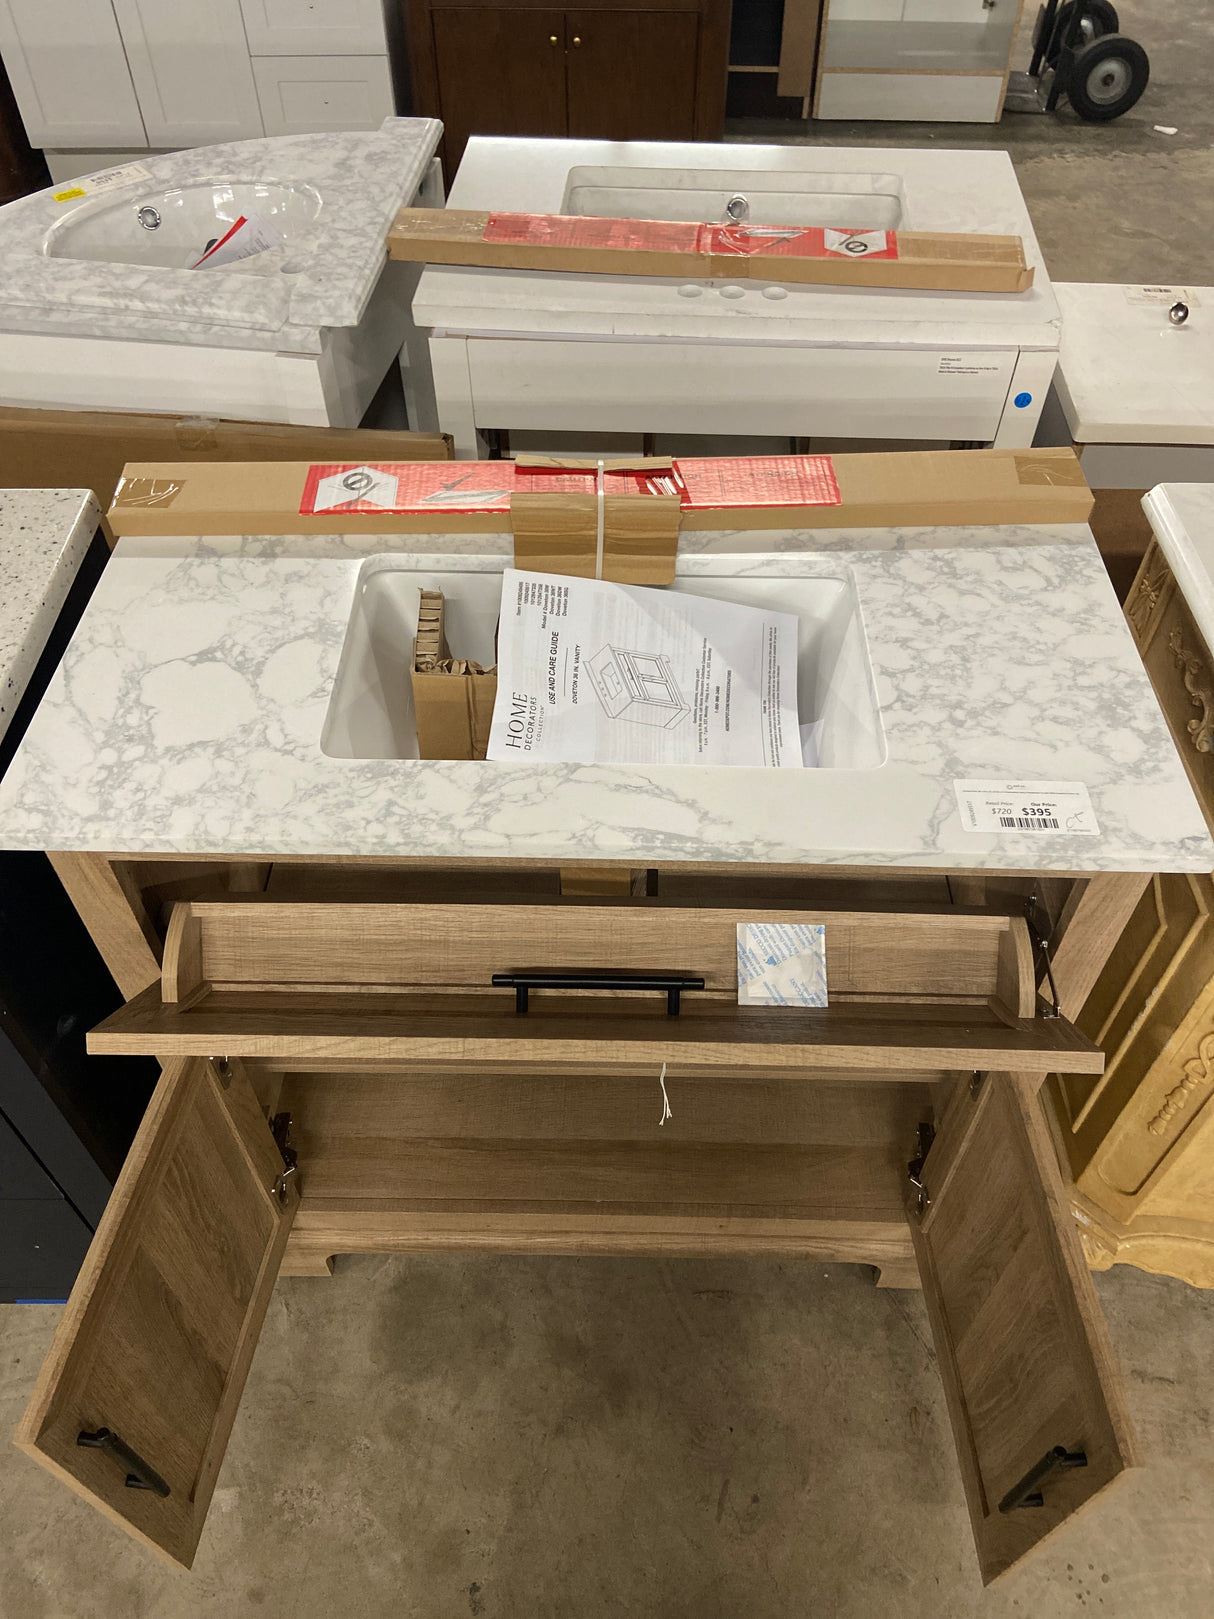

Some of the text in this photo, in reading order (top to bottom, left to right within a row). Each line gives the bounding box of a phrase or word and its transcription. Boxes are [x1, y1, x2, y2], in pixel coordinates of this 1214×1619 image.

[550, 632, 559, 655] GUIDE
[549, 657, 557, 676] CARE
[506, 692, 528, 748] HOME
[525, 697, 537, 750] DECORATORS
[1022, 807, 1052, 816] $395
